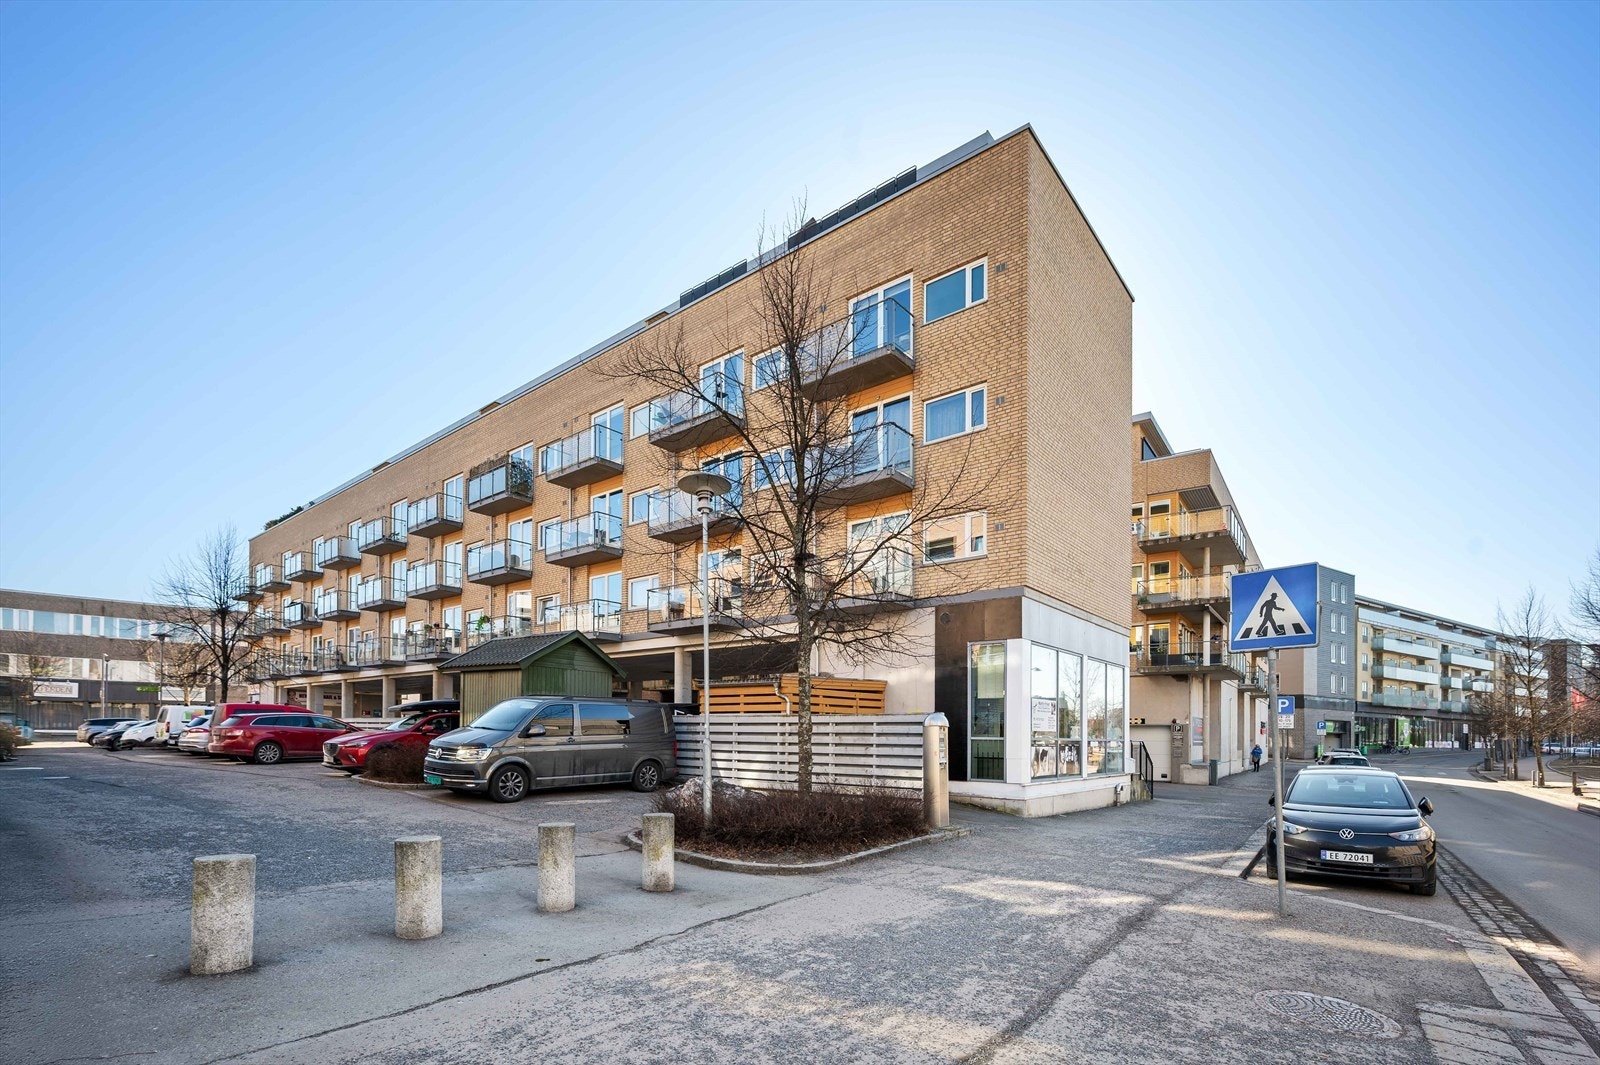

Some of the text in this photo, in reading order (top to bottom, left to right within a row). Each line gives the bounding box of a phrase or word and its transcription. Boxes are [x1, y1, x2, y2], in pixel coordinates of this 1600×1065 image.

[1278, 698, 1289, 712] P
[1329, 852, 1369, 862] EE 72041
